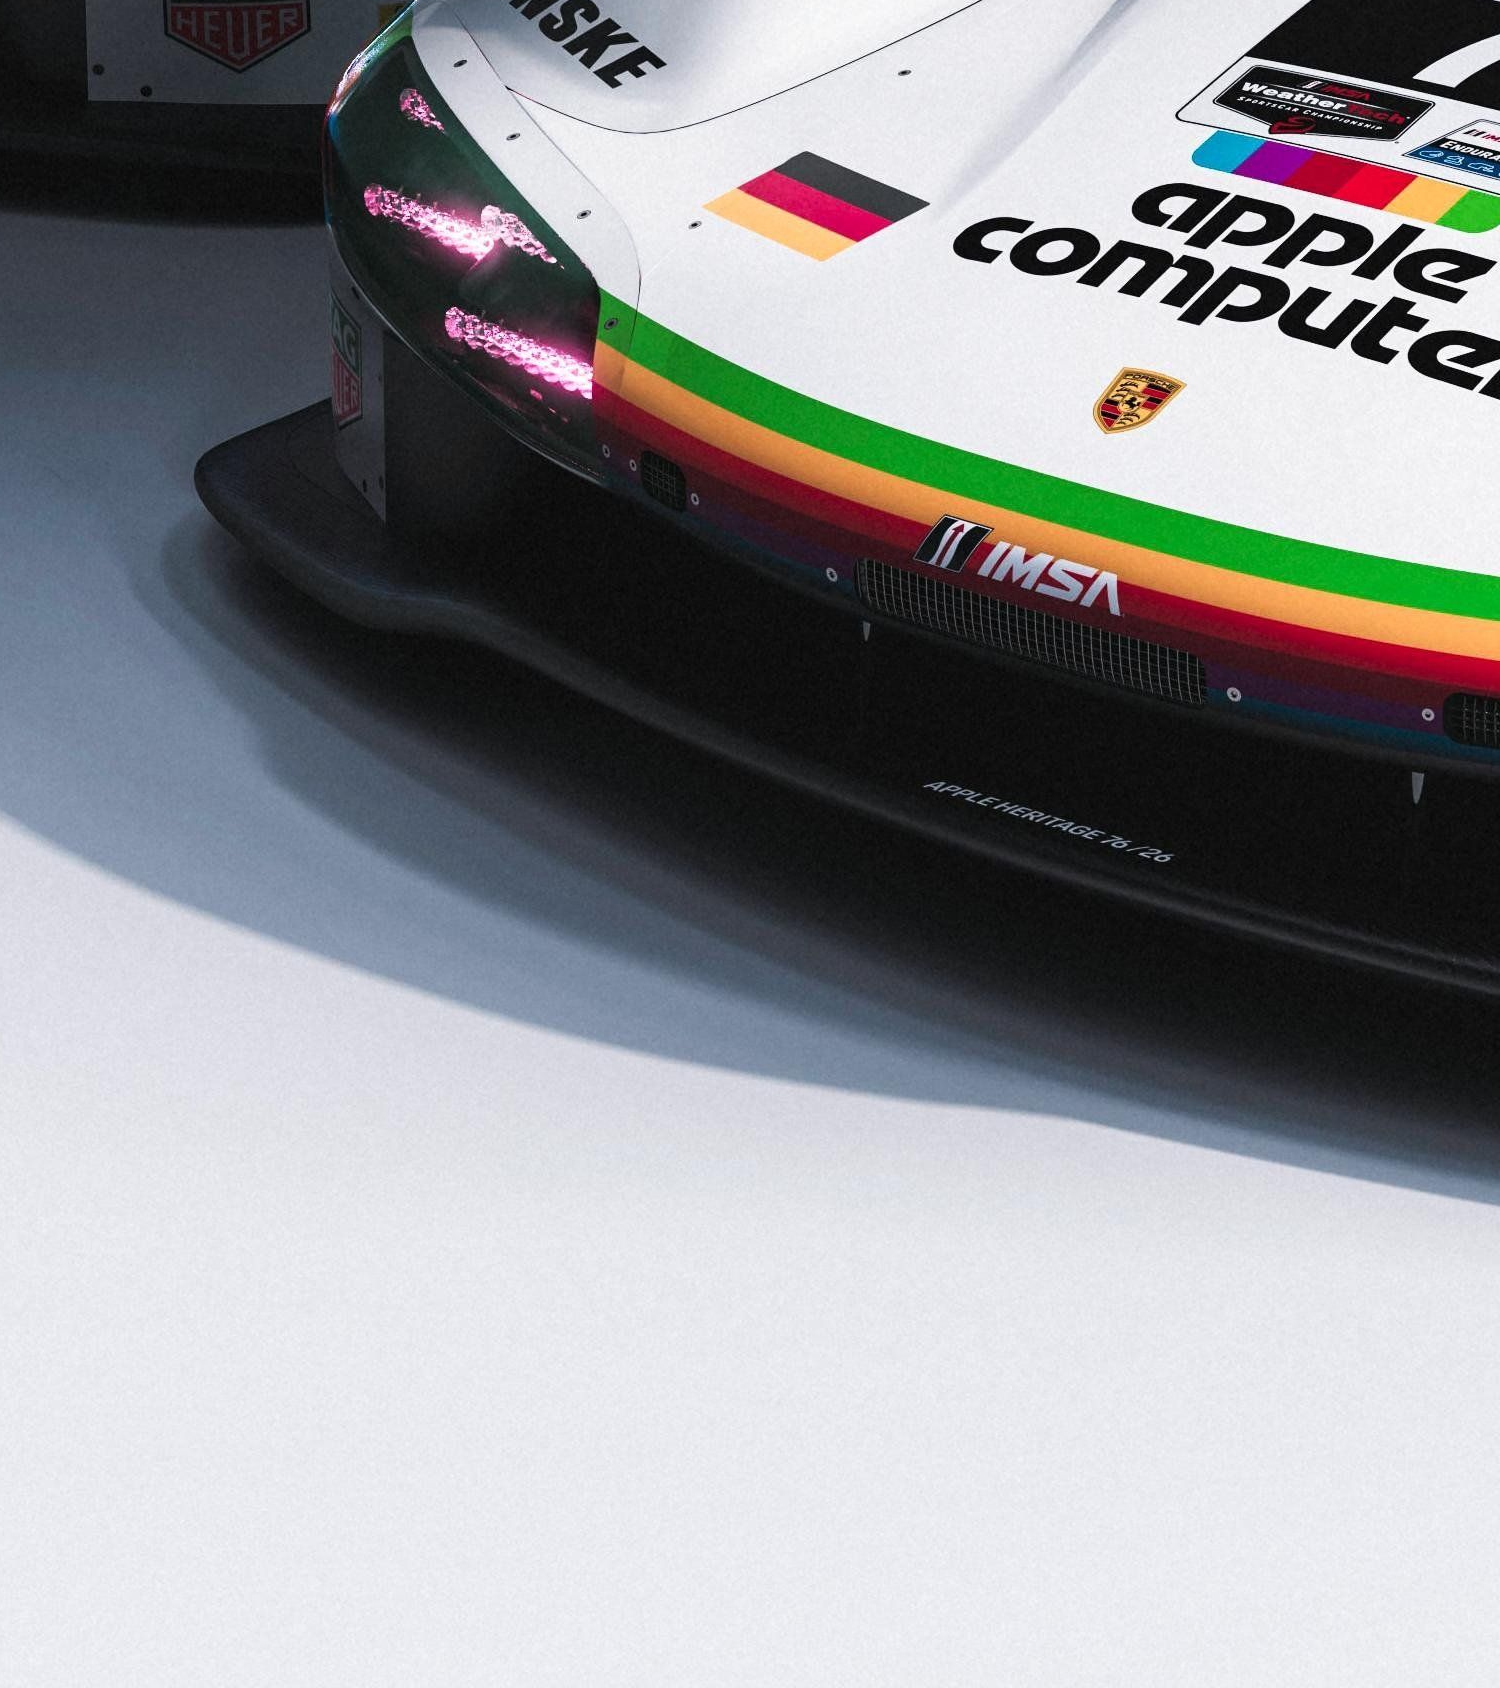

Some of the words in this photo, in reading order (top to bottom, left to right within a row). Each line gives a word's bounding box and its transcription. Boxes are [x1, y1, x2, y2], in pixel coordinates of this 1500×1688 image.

[176, 6, 300, 60] HEUER
[1242, 81, 1406, 125] WeatherTech
[1130, 181, 1499, 305] apple
[976, 540, 1123, 617] IMSA
[922, 780, 1000, 807] APPLE
[992, 802, 1105, 841] HERITAGE
